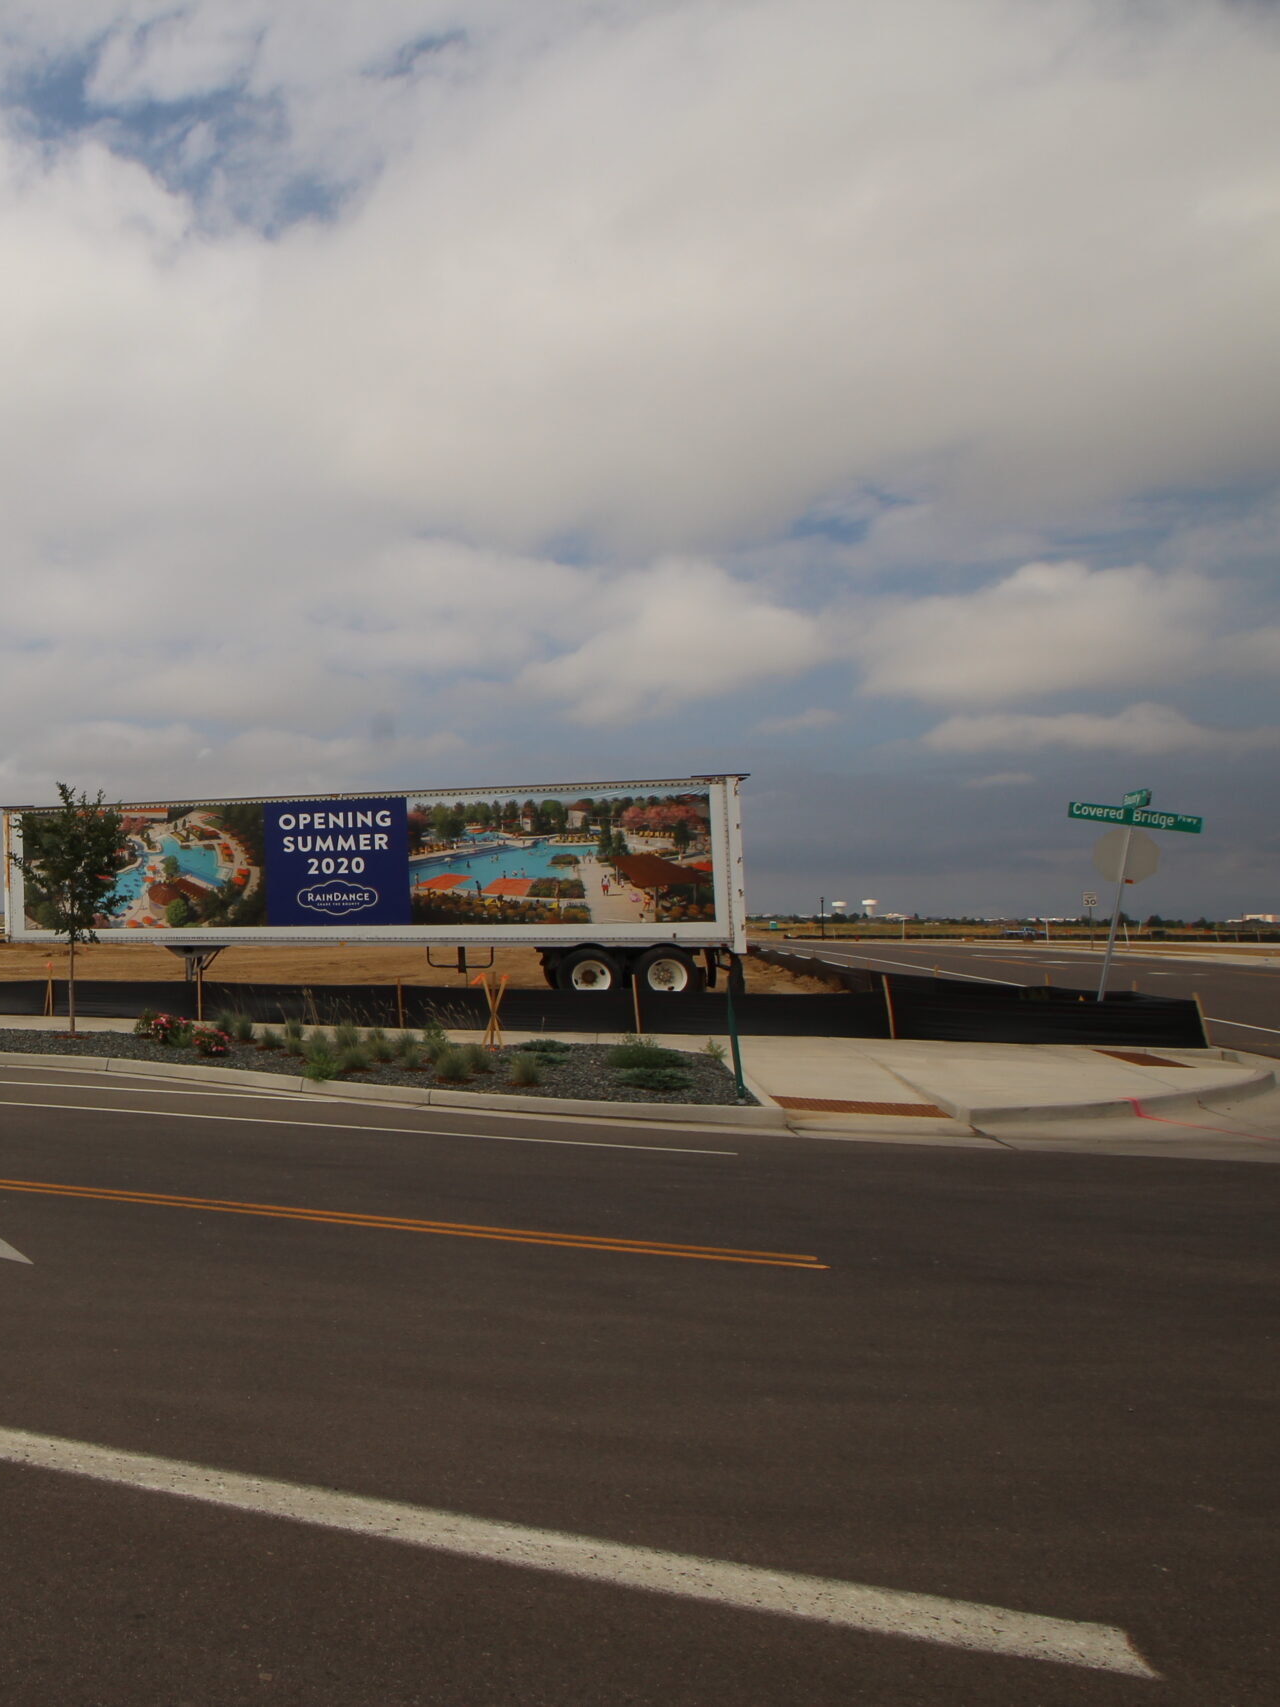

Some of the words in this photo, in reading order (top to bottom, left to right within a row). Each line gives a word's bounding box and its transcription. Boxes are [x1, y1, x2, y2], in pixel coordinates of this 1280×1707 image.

[278, 810, 392, 830] OPENING
[1072, 802, 1124, 820] Covered
[1132, 809, 1175, 829] Bridge
[283, 833, 389, 853] SUMMER
[307, 857, 365, 875] 2020
